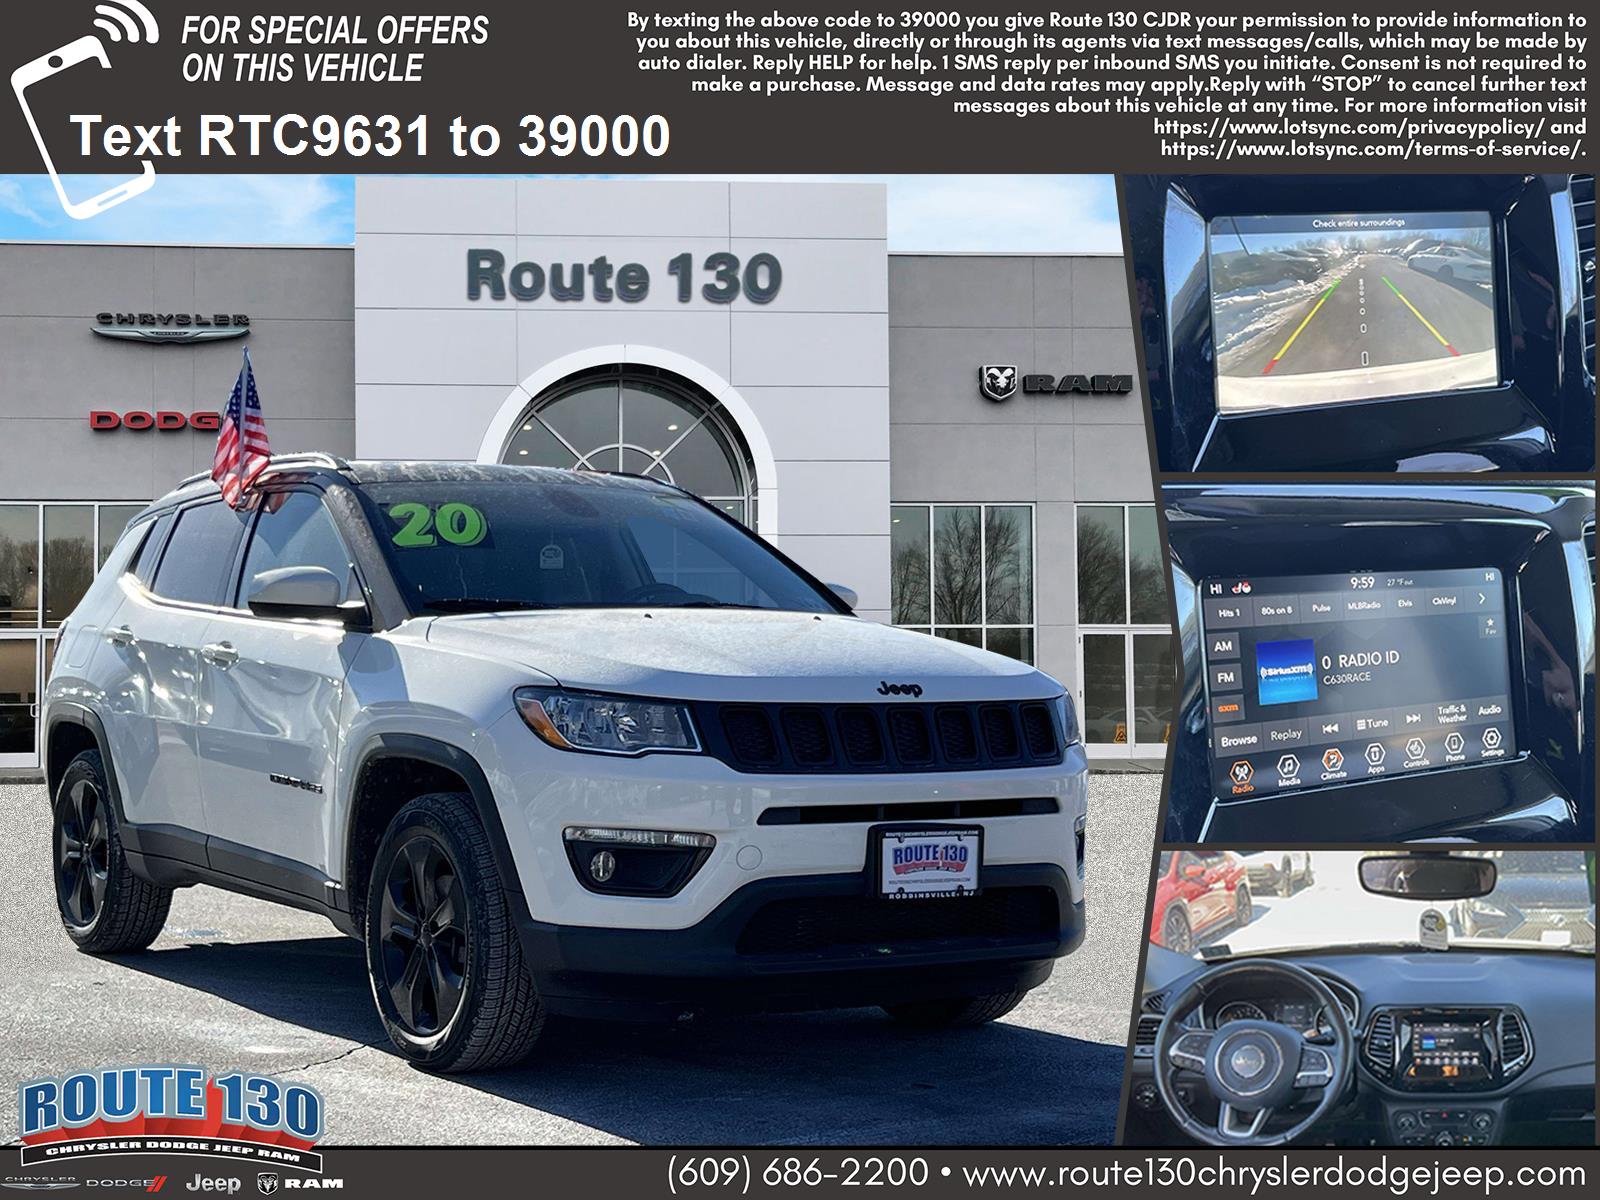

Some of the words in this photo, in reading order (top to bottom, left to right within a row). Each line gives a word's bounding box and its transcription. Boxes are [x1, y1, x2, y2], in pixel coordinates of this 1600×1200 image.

[1312, 219, 1336, 228] Check
[1337, 219, 1359, 227] entire
[1360, 218, 1405, 228] surroundings
[467, 248, 650, 302] Route
[667, 252, 782, 304] 130
[96, 313, 249, 326] CHRYSLER
[1023, 374, 1133, 394] RAM
[90, 411, 220, 430] DODG
[389, 502, 487, 547] 20
[1350, 576, 1375, 589] 9:59
[1219, 608, 1234, 618] Hits
[1261, 606, 1275, 616] 80s
[1312, 604, 1331, 613] Pulse
[1214, 641, 1232, 652] AM
[1339, 652, 1382, 668] RADIO
[1385, 650, 1400, 664] ID
[1218, 672, 1234, 683] FM
[1323, 672, 1371, 685] C630RACE
[877, 681, 923, 698] Jeep
[1438, 704, 1459, 715] Traffic
[1478, 704, 1502, 716] Audio
[1367, 718, 1389, 729] Tune
[1438, 714, 1467, 724] Weather
[1271, 729, 1302, 741] Replay
[1221, 735, 1258, 747] Browse
[1445, 754, 1465, 762] Phone
[1481, 748, 1505, 758] Settings
[1403, 758, 1430, 768] Controls
[1321, 771, 1347, 781] Climate
[1367, 766, 1385, 775] Apps
[1278, 778, 1301, 787] Media
[1232, 784, 1255, 794] Radio
[893, 844, 939, 864] ROUTE
[943, 845, 968, 863] 130
